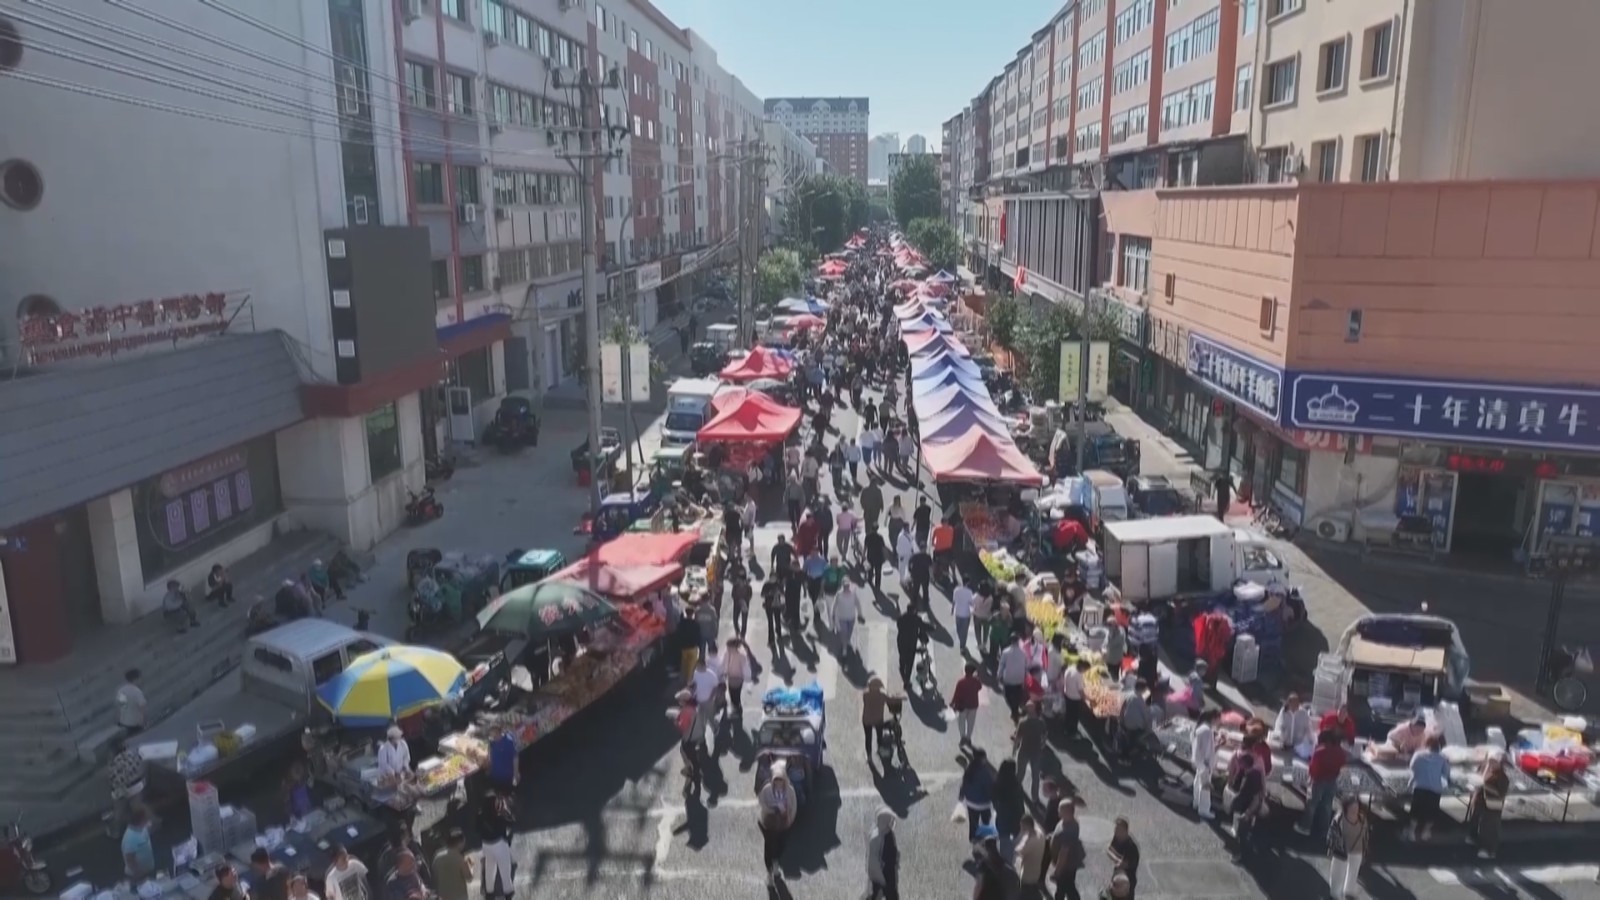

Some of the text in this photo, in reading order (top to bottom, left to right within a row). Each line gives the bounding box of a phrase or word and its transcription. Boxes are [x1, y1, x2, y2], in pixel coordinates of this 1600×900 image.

[1368, 392, 1600, 437] 二十年清真牛
